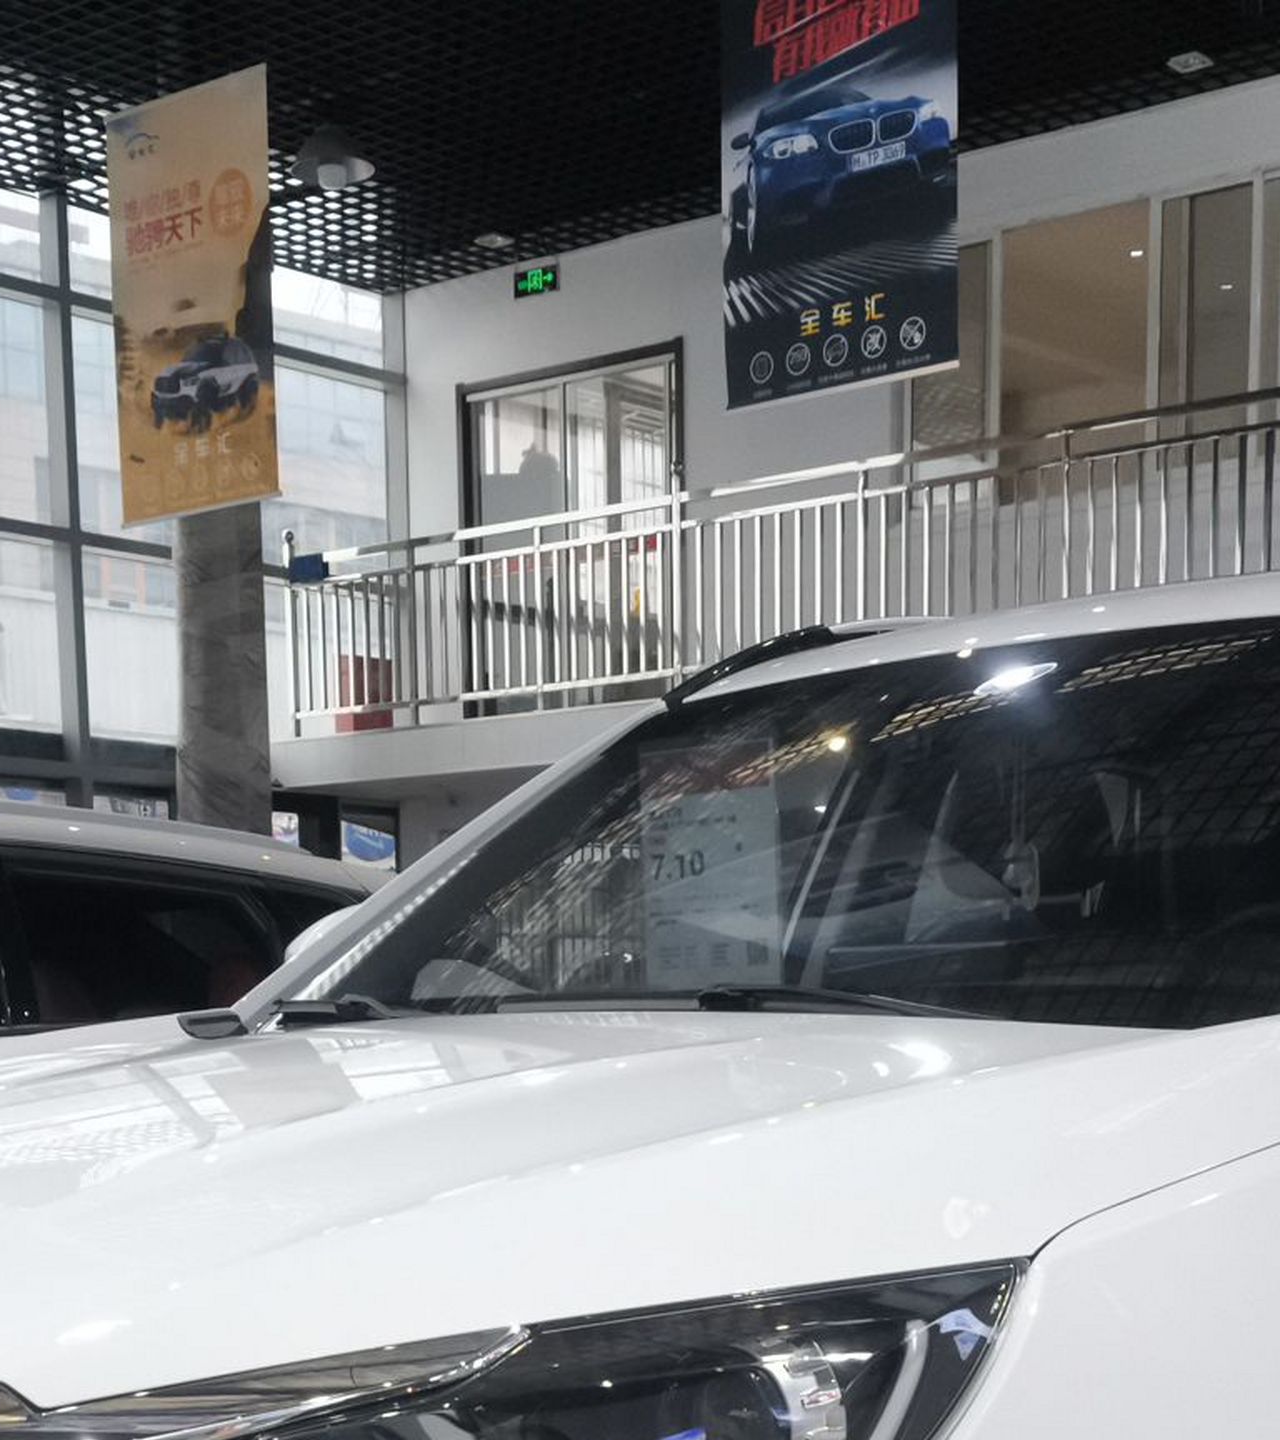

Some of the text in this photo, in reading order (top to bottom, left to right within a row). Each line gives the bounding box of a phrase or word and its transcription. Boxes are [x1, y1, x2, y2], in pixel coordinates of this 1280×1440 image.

[799, 292, 887, 337] 全车汇
[652, 850, 705, 881] 7.10
